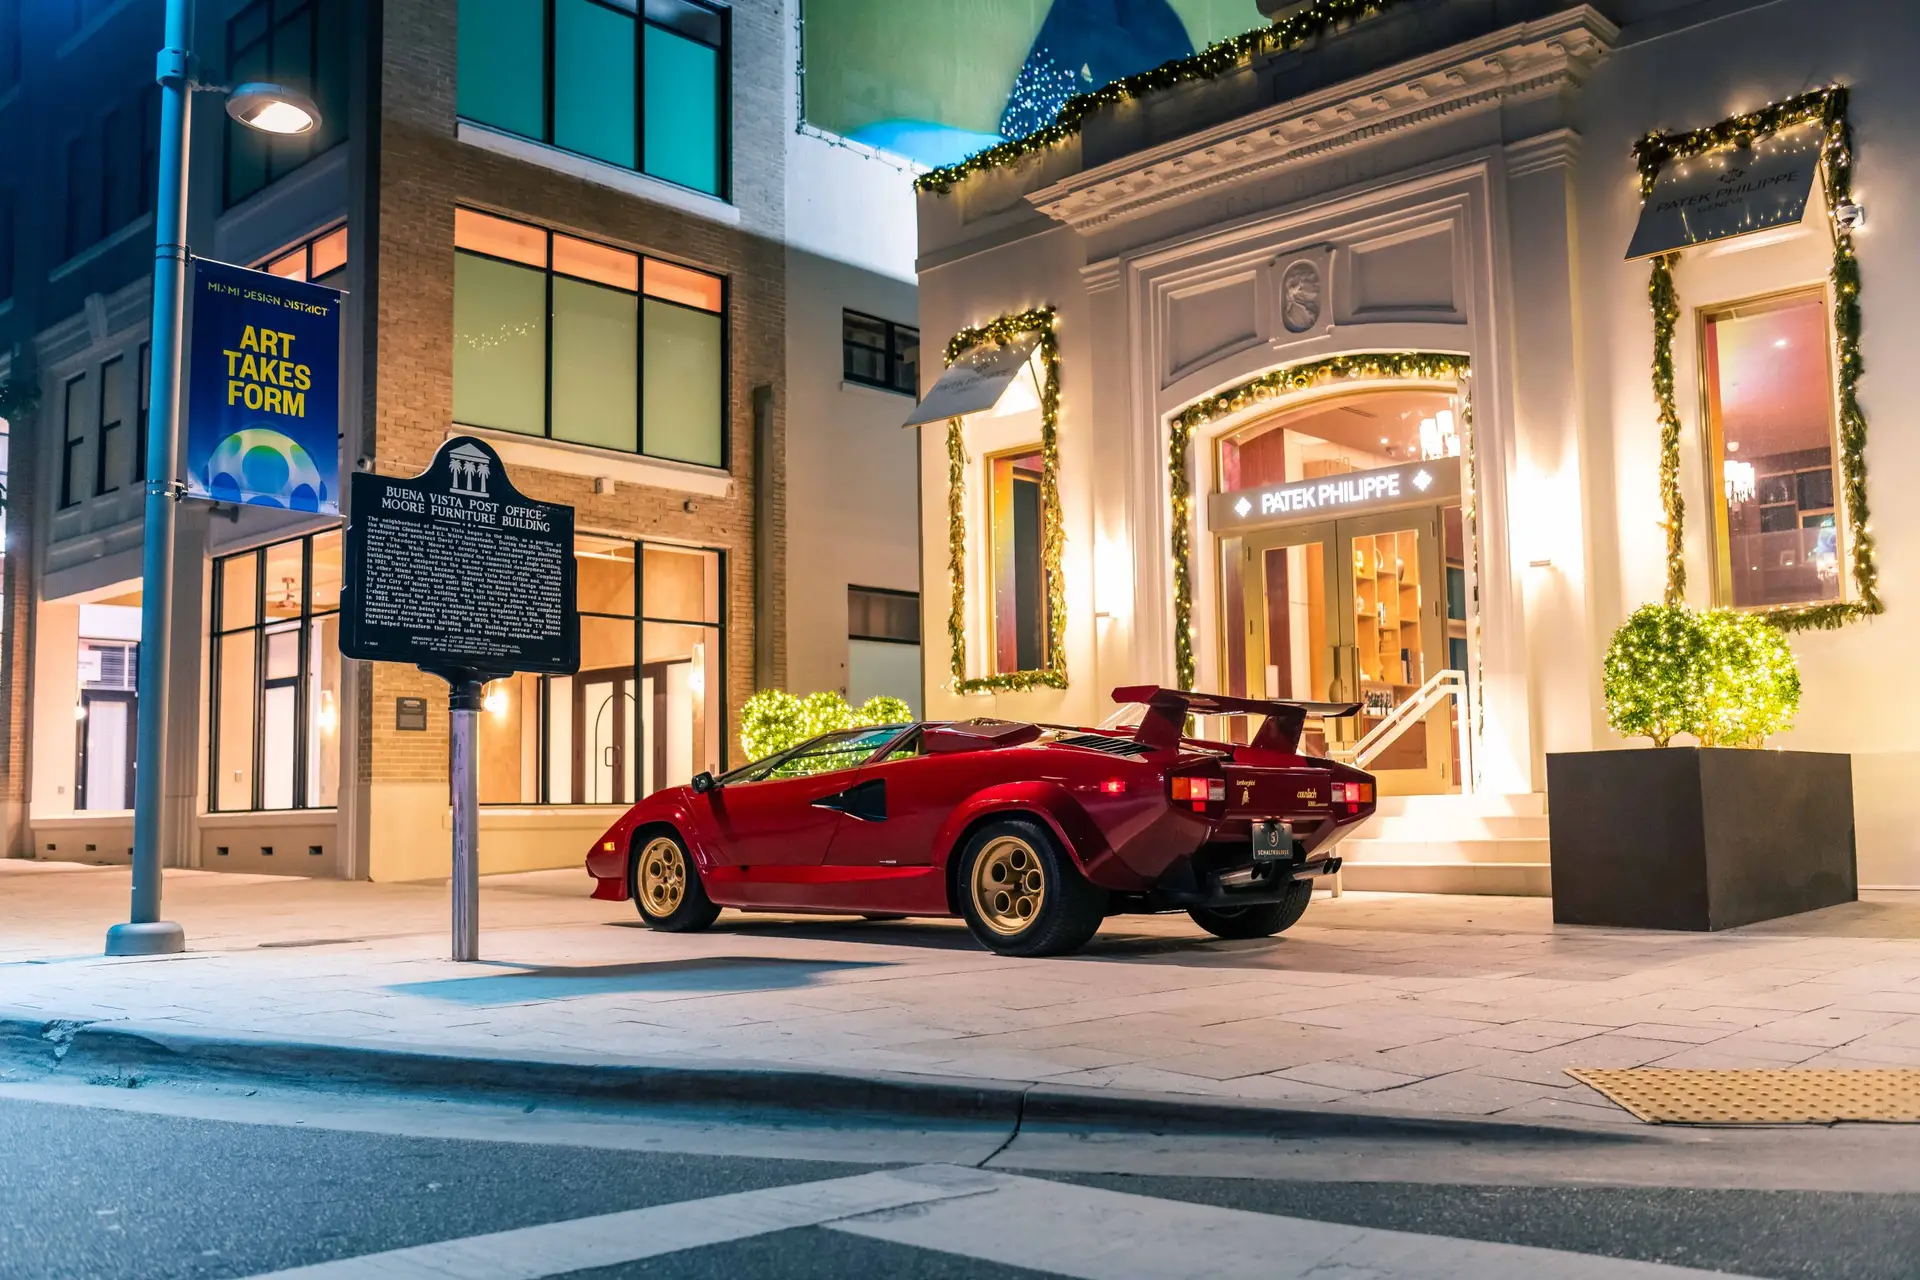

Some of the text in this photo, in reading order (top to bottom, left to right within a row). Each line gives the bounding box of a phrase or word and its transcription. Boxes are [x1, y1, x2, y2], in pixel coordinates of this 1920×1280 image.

[1656, 171, 1800, 212] PATEK PHILIPPE
[208, 282, 328, 316] MIAMI DESIGN DISTRICT
[240, 325, 296, 358] ART
[223, 350, 311, 390] TAKES
[228, 380, 304, 418] FORM
[386, 486, 424, 502] BUENA
[429, 494, 464, 508] VISTA
[469, 500, 500, 513] POST
[1262, 474, 1400, 514] PATEK PHILIPPE
[382, 498, 550, 532] MOORE FURNITURE BUILDING
